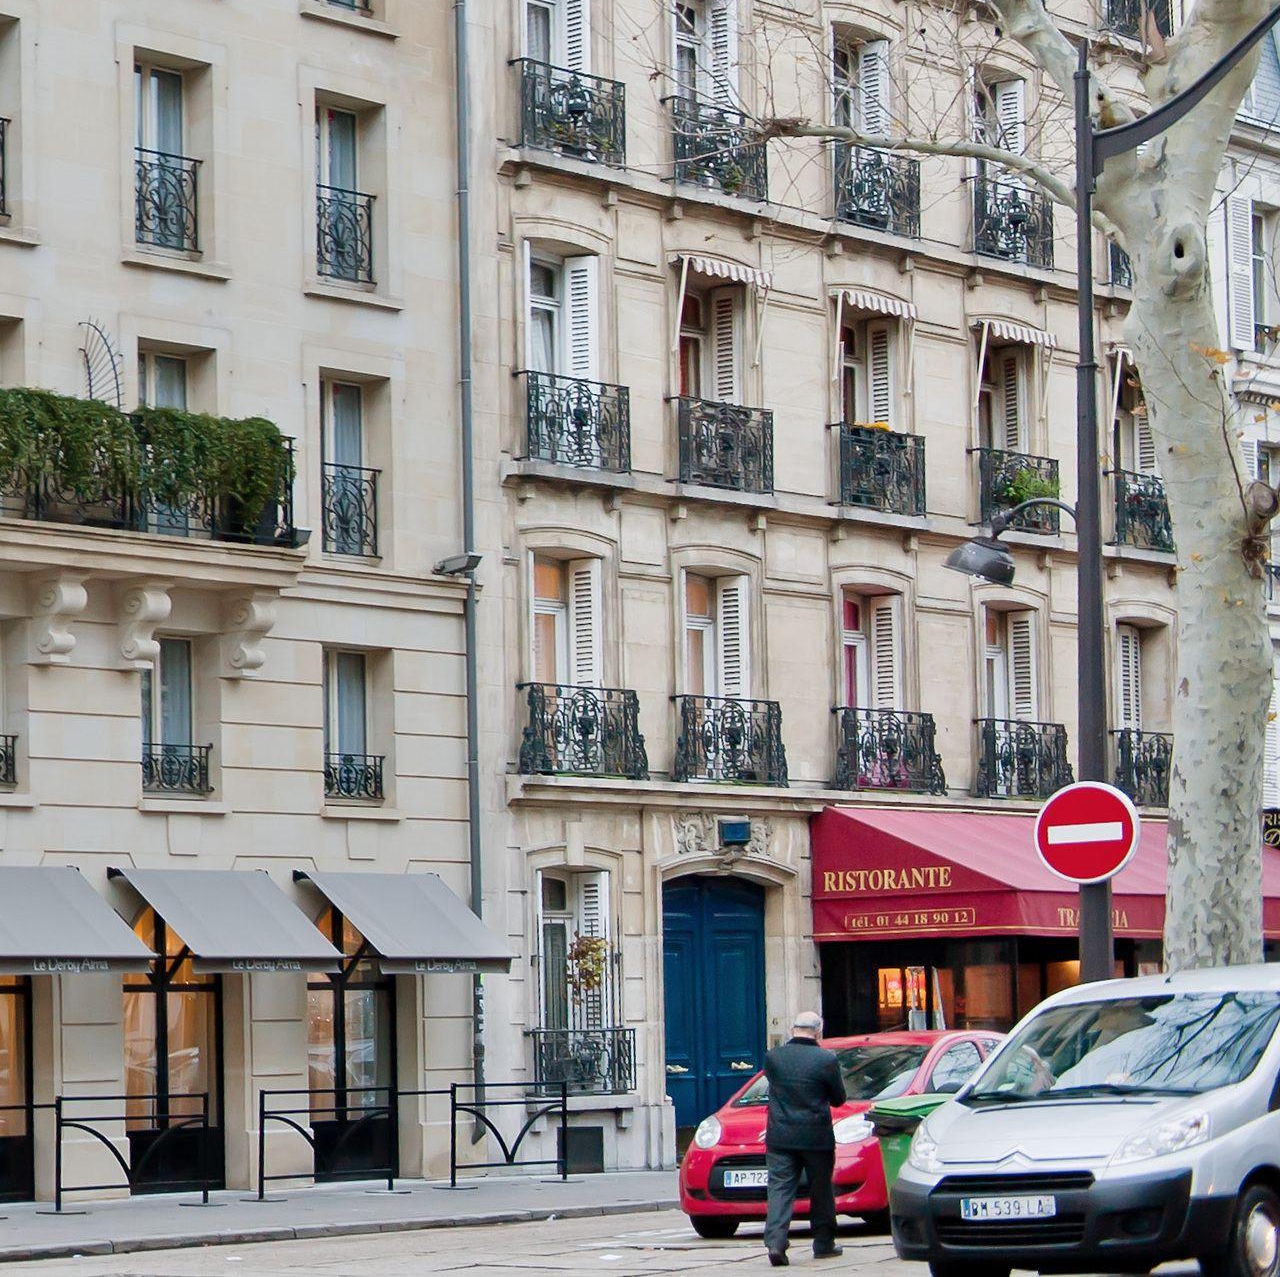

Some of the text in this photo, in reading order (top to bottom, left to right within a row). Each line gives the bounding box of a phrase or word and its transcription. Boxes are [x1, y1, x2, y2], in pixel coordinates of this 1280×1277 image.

[1260, 813, 1280, 826] RI
[823, 866, 953, 892] RISTORANTE
[876, 915, 889, 927] 01
[894, 913, 909, 926] 44
[913, 913, 928, 925] 18
[933, 912, 949, 924] 90
[954, 911, 968, 923] 12
